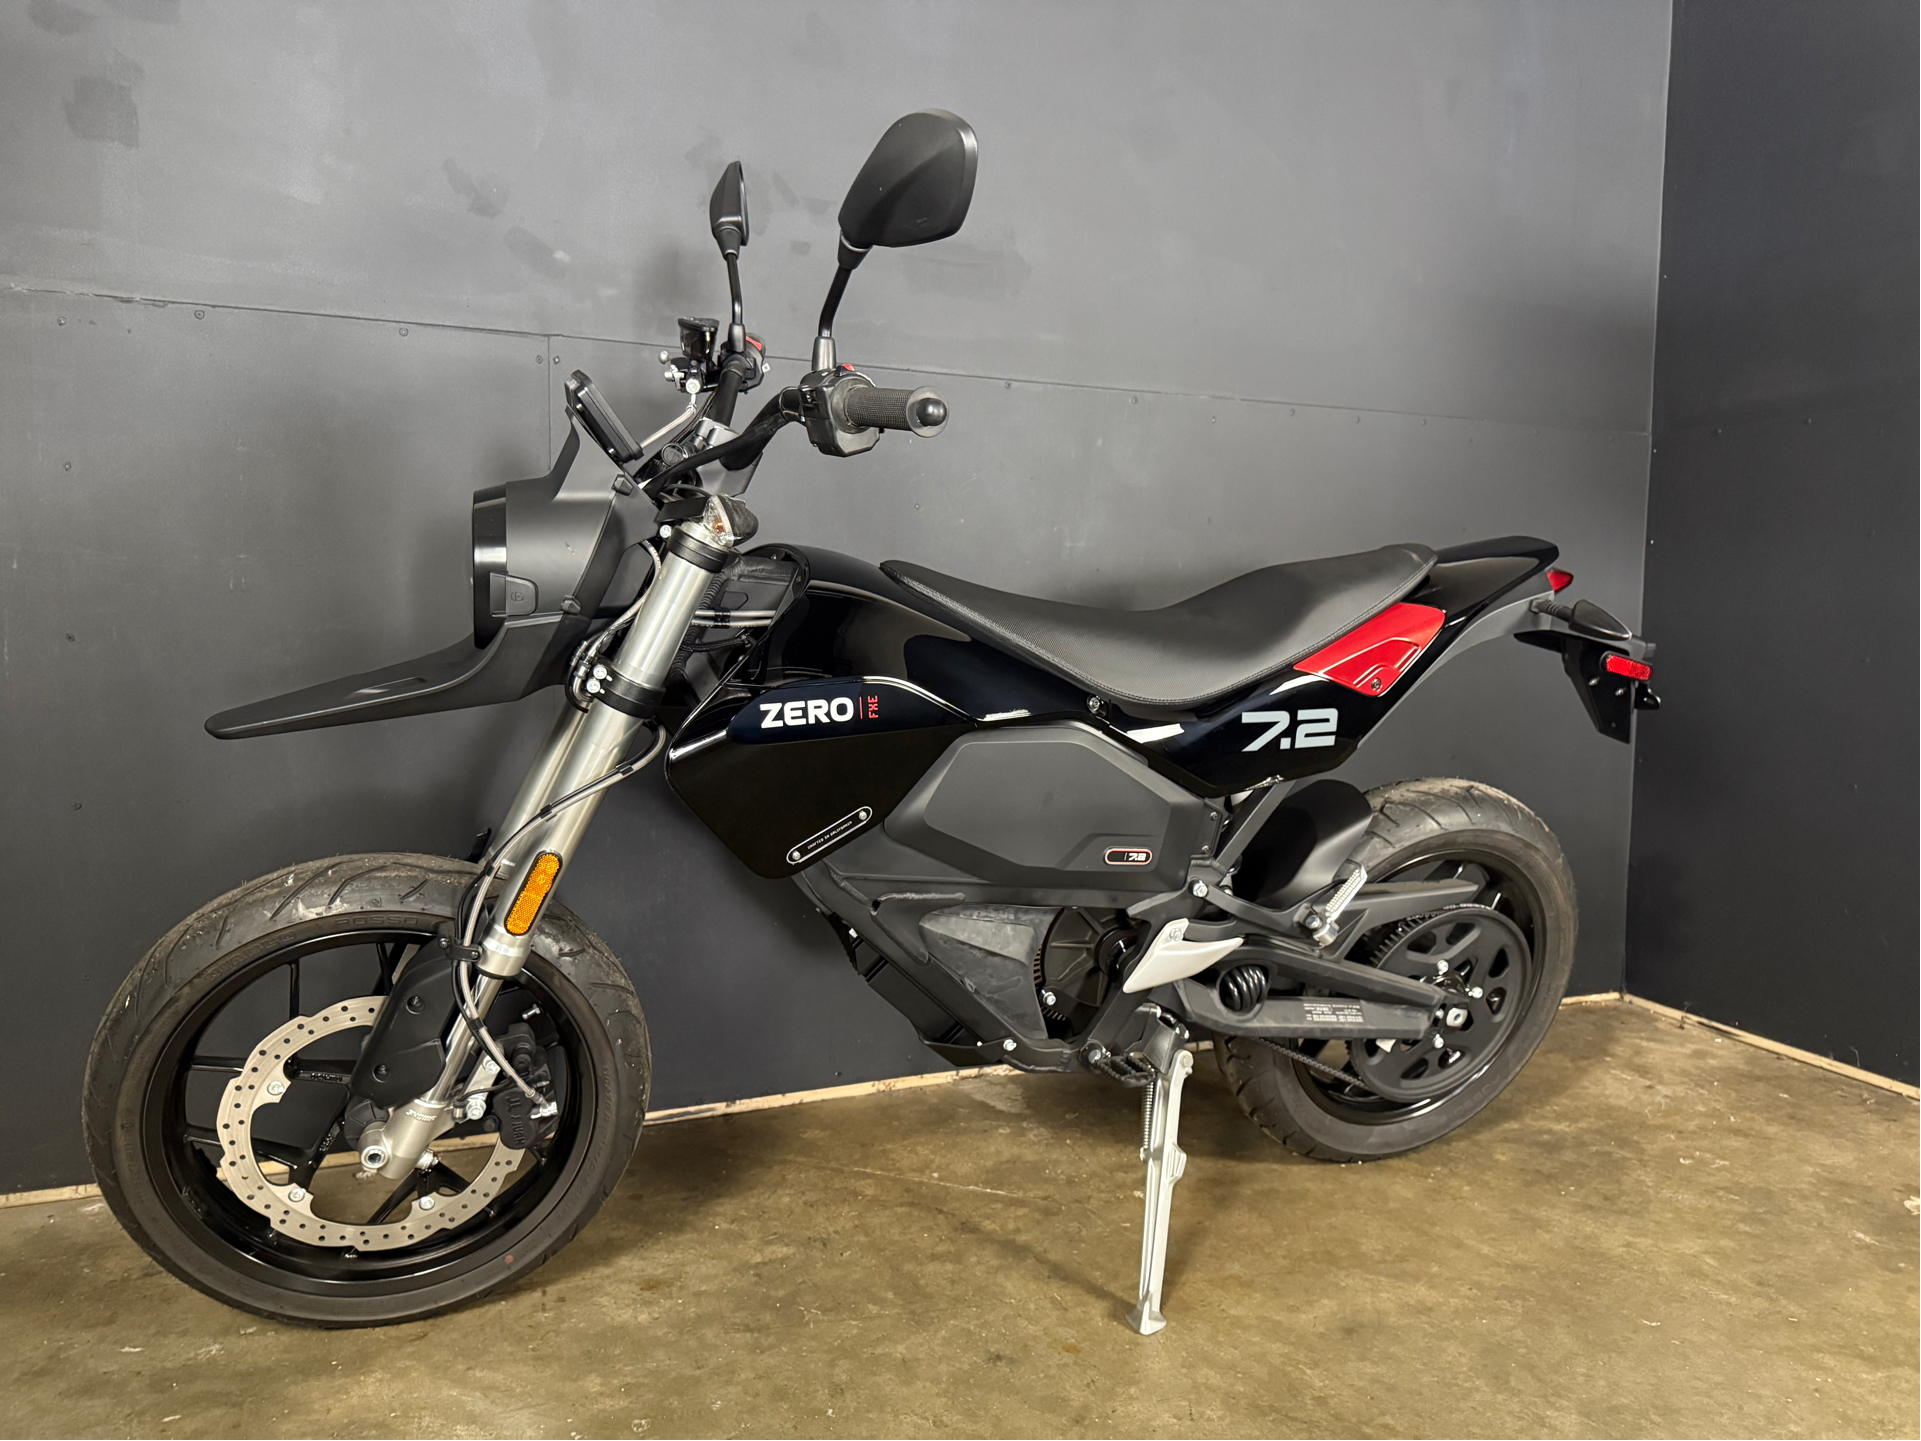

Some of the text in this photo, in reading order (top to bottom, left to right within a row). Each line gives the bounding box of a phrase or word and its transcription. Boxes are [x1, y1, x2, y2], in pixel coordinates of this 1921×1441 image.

[759, 694, 880, 729] ZERO FXE
[1241, 707, 1339, 753] 7.2
[202, 930, 297, 984] DIABLO
